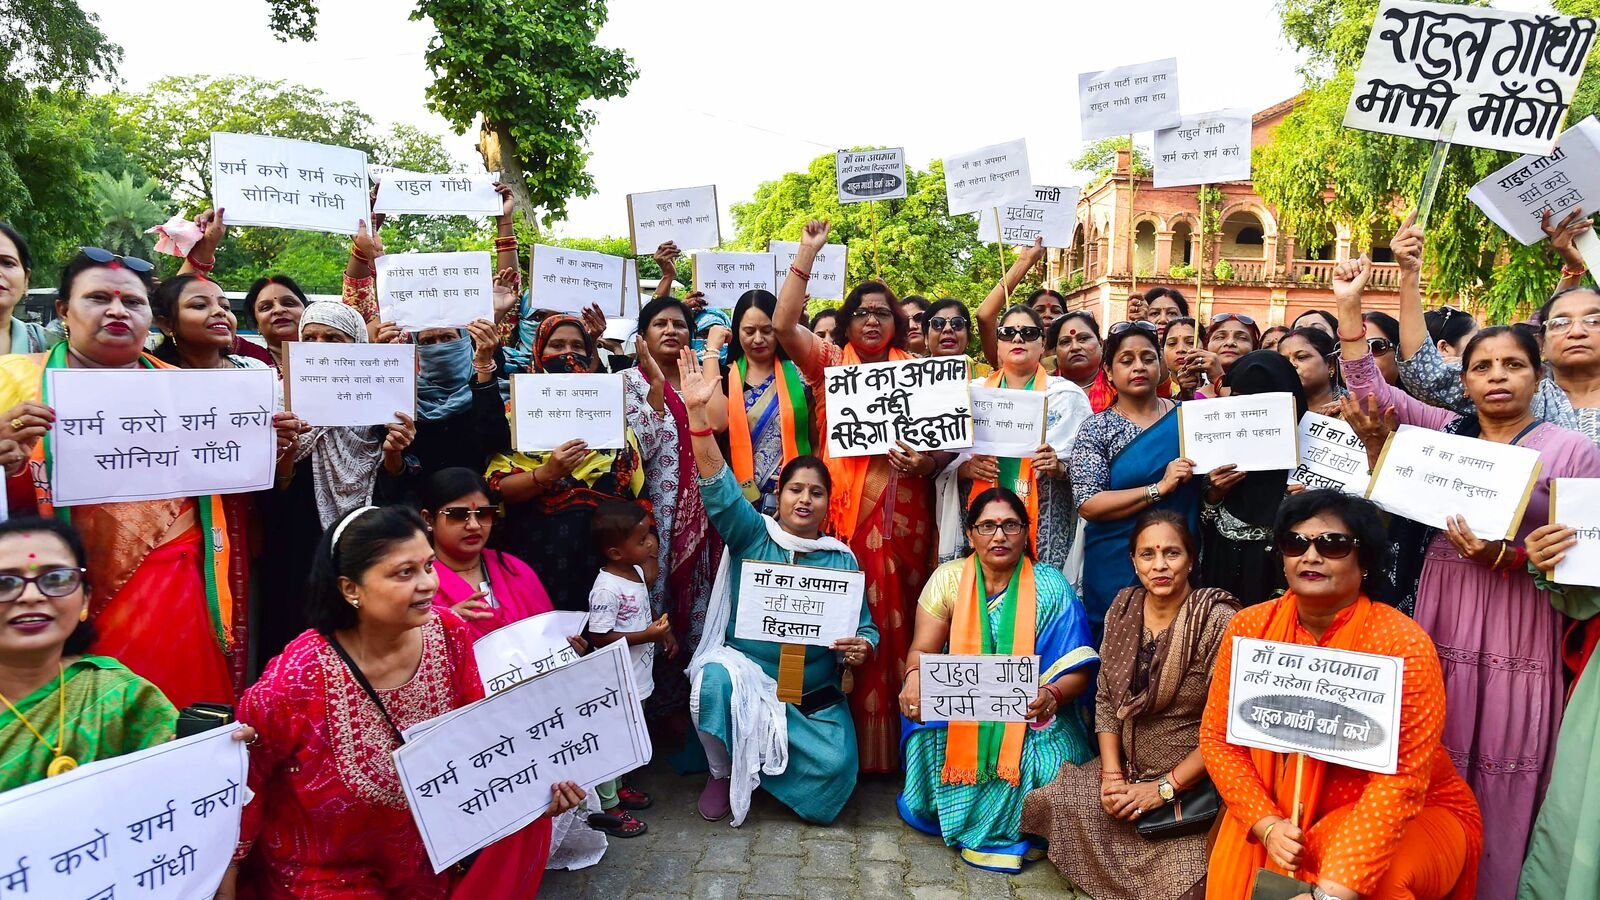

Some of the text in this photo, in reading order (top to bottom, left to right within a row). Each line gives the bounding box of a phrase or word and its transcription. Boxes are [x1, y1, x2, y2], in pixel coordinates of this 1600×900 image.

[1380, 8, 1505, 83] राहुल
[1087, 73, 1166, 94] कांग्रेस पार्टी हाय हाय
[1090, 92, 1166, 112] राहुल गांधी हाय हाय
[1355, 78, 1571, 141] माफी माँगो
[1177, 123, 1225, 141] राहुल गांधी
[867, 153, 896, 162] अपमान
[984, 155, 1007, 165] अपमान
[1162, 144, 1240, 163] शर्म करो शर्म करो
[219, 159, 364, 189] शर्म करो शर्म करो
[968, 176, 986, 186] सहेगा
[990, 169, 1020, 182] हिन्दुस्तान
[1497, 165, 1532, 187] राहुल
[394, 178, 472, 196] राहुल गाँधी
[1035, 187, 1061, 202] गांधी
[1517, 171, 1569, 202] शर्म करो
[240, 185, 346, 211] सोनियां गाँधी
[656, 200, 690, 211] राहुल गांधी
[1554, 188, 1583, 207] करो
[1007, 204, 1045, 221] मुर्दाबाद
[387, 265, 479, 278] कांग्रेस पार्टी हाय हाय
[567, 259, 577, 267] का
[581, 261, 604, 270] अपमान
[716, 262, 755, 273] राहुल गांधी
[560, 276, 580, 286] सहेगा
[583, 278, 613, 290] हिन्दुस्तान
[705, 280, 767, 290] शर्म करो शर्म करो
[390, 288, 479, 300] राहुल गांधी हाय हाय
[305, 357, 399, 367] मां की गरिमा रखनी होगी
[300, 375, 327, 383] अपमान
[331, 374, 350, 384] करने
[375, 375, 385, 384] को
[828, 359, 966, 395] माँ का अपमान
[336, 392, 372, 401] देनी होगी
[556, 389, 567, 397] का
[572, 389, 598, 397] अपमान
[548, 408, 572, 419] सहेगा
[576, 407, 611, 420] हिन्दुस्तान
[974, 401, 1014, 410] राहुल गांधी
[1204, 409, 1268, 422] नारी का सम्मान
[60, 405, 270, 436] शर्म करो शर्म करो
[831, 408, 889, 449] सहेगा
[1194, 428, 1281, 444] हिन्दुस्तान की पहचान
[1309, 421, 1345, 443] माँ का
[94, 441, 242, 470] सोनियां गाँधी
[1308, 446, 1360, 473] नहीं सहेगा
[1422, 446, 1495, 472] माँ का अपमान
[754, 568, 849, 593] माँ का अपमान
[764, 595, 825, 614] नहीं सहेगा
[762, 615, 821, 638] हिंदुस्तान
[1252, 645, 1381, 682] माँ का अपमान
[487, 664, 523, 692] करो
[926, 661, 983, 688] राहुल
[1243, 669, 1386, 705] नहीं सहेगा हिन्दुस्तान
[929, 687, 1033, 718] शर्म करो
[1251, 705, 1372, 742] राहुल गांधी शर्म करो
[416, 687, 619, 799] शर्म करो शर्म करो
[458, 732, 600, 817] सोनियां गाँधी
[0, 779, 240, 893] र्म करो शर्म करो
[134, 845, 198, 890] गाँधी
